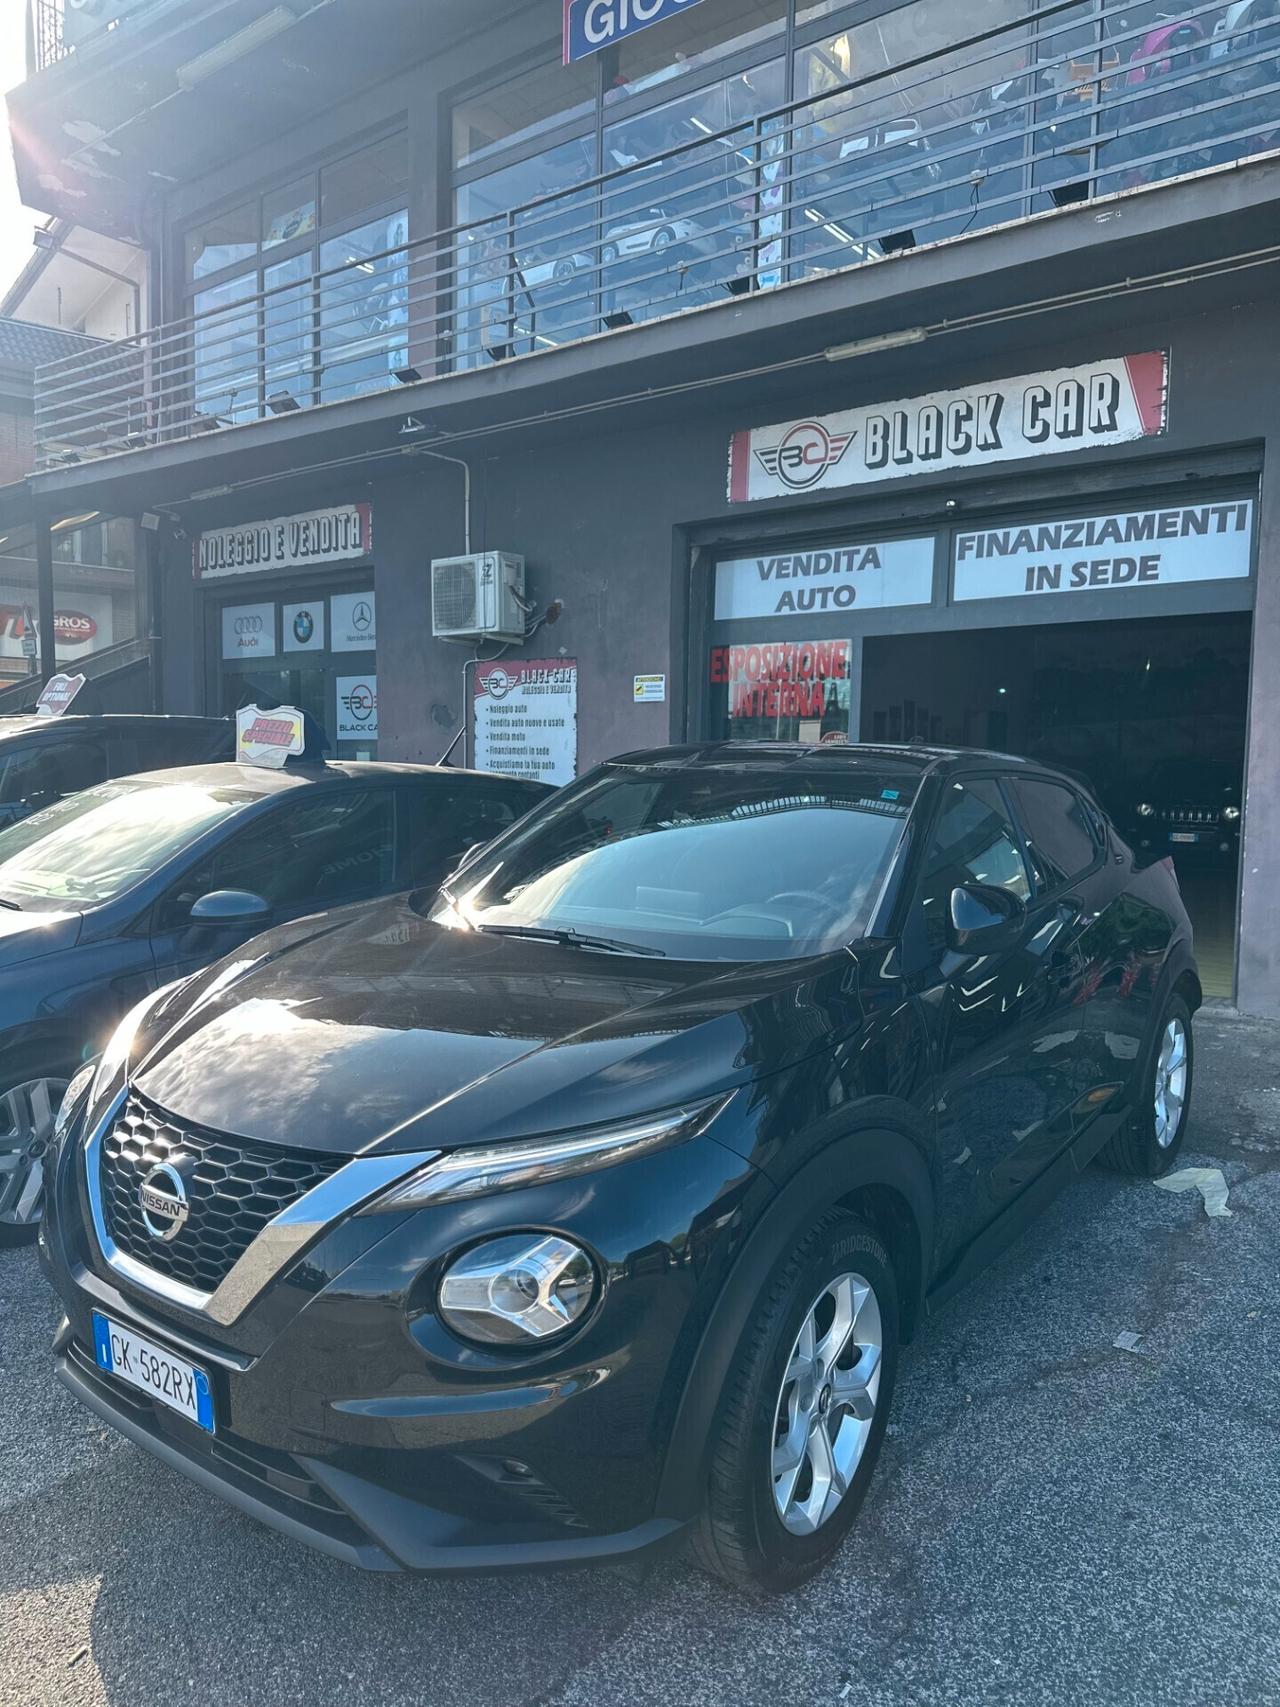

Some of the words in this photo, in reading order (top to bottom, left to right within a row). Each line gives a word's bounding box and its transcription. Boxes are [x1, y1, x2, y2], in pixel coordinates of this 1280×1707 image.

[864, 393, 1004, 470] BLACK
[1022, 373, 1120, 443] CAR
[200, 526, 271, 570] NOLEGGIO
[275, 525, 285, 559] E
[288, 511, 363, 557] VENDITA
[957, 503, 1248, 561] FINANZIAMENTI
[756, 547, 881, 581] VENDITA
[1025, 565, 1061, 593] IN
[1070, 554, 1162, 588] SEDE
[775, 584, 856, 613] AUTO
[237, 636, 259, 648] Audi
[710, 641, 848, 683] ESPOSIZIONE
[733, 681, 825, 717] INTERNA
[339, 724, 366, 732] BLACK
[140, 1191, 181, 1217] NISSAN
[111, 1334, 133, 1374] GK
[139, 1349, 197, 1410] 582RX
